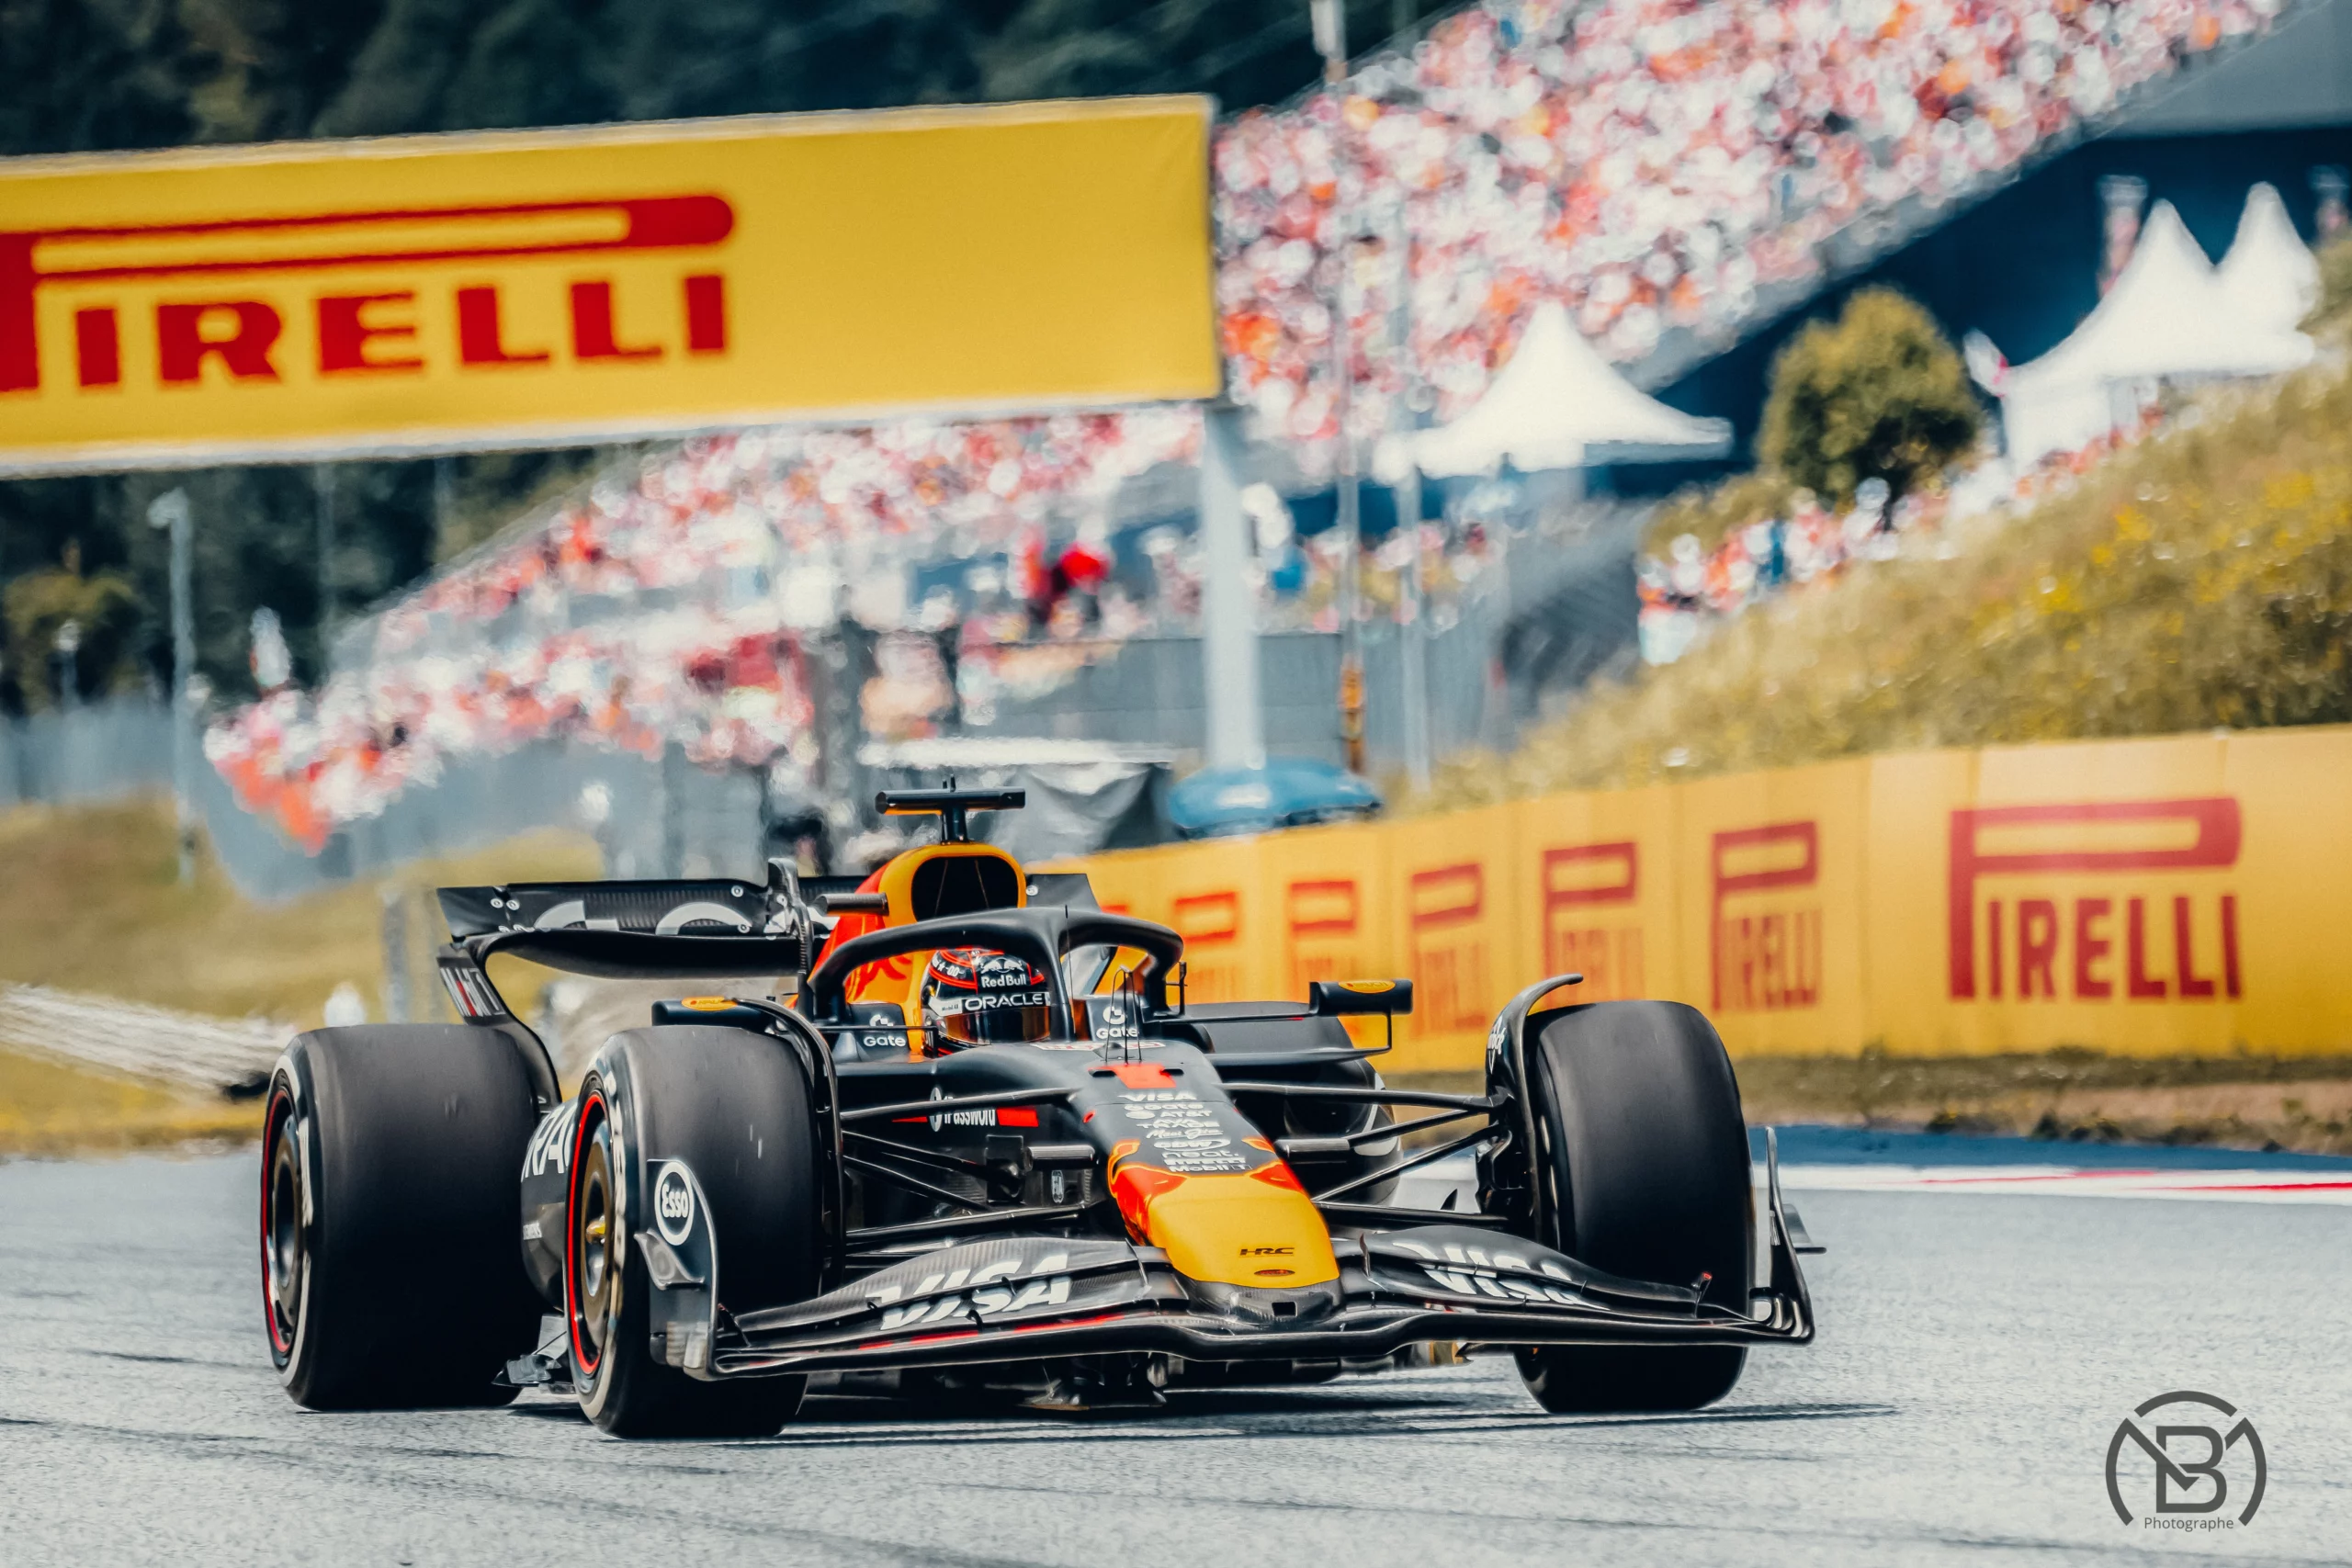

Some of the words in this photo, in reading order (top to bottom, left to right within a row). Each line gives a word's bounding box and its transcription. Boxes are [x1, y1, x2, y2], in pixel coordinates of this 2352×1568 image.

[0, 195, 735, 391] PIRELLI
[1948, 795, 2244, 1003] PIRELLI
[965, 992, 1045, 1011] ORACLE
[1117, 1091, 1197, 1102] VISA
[1159, 1110, 1213, 1118] AT&T
[1169, 1164, 1229, 1173] Mobil
[1239, 1247, 1295, 1256] HRC
